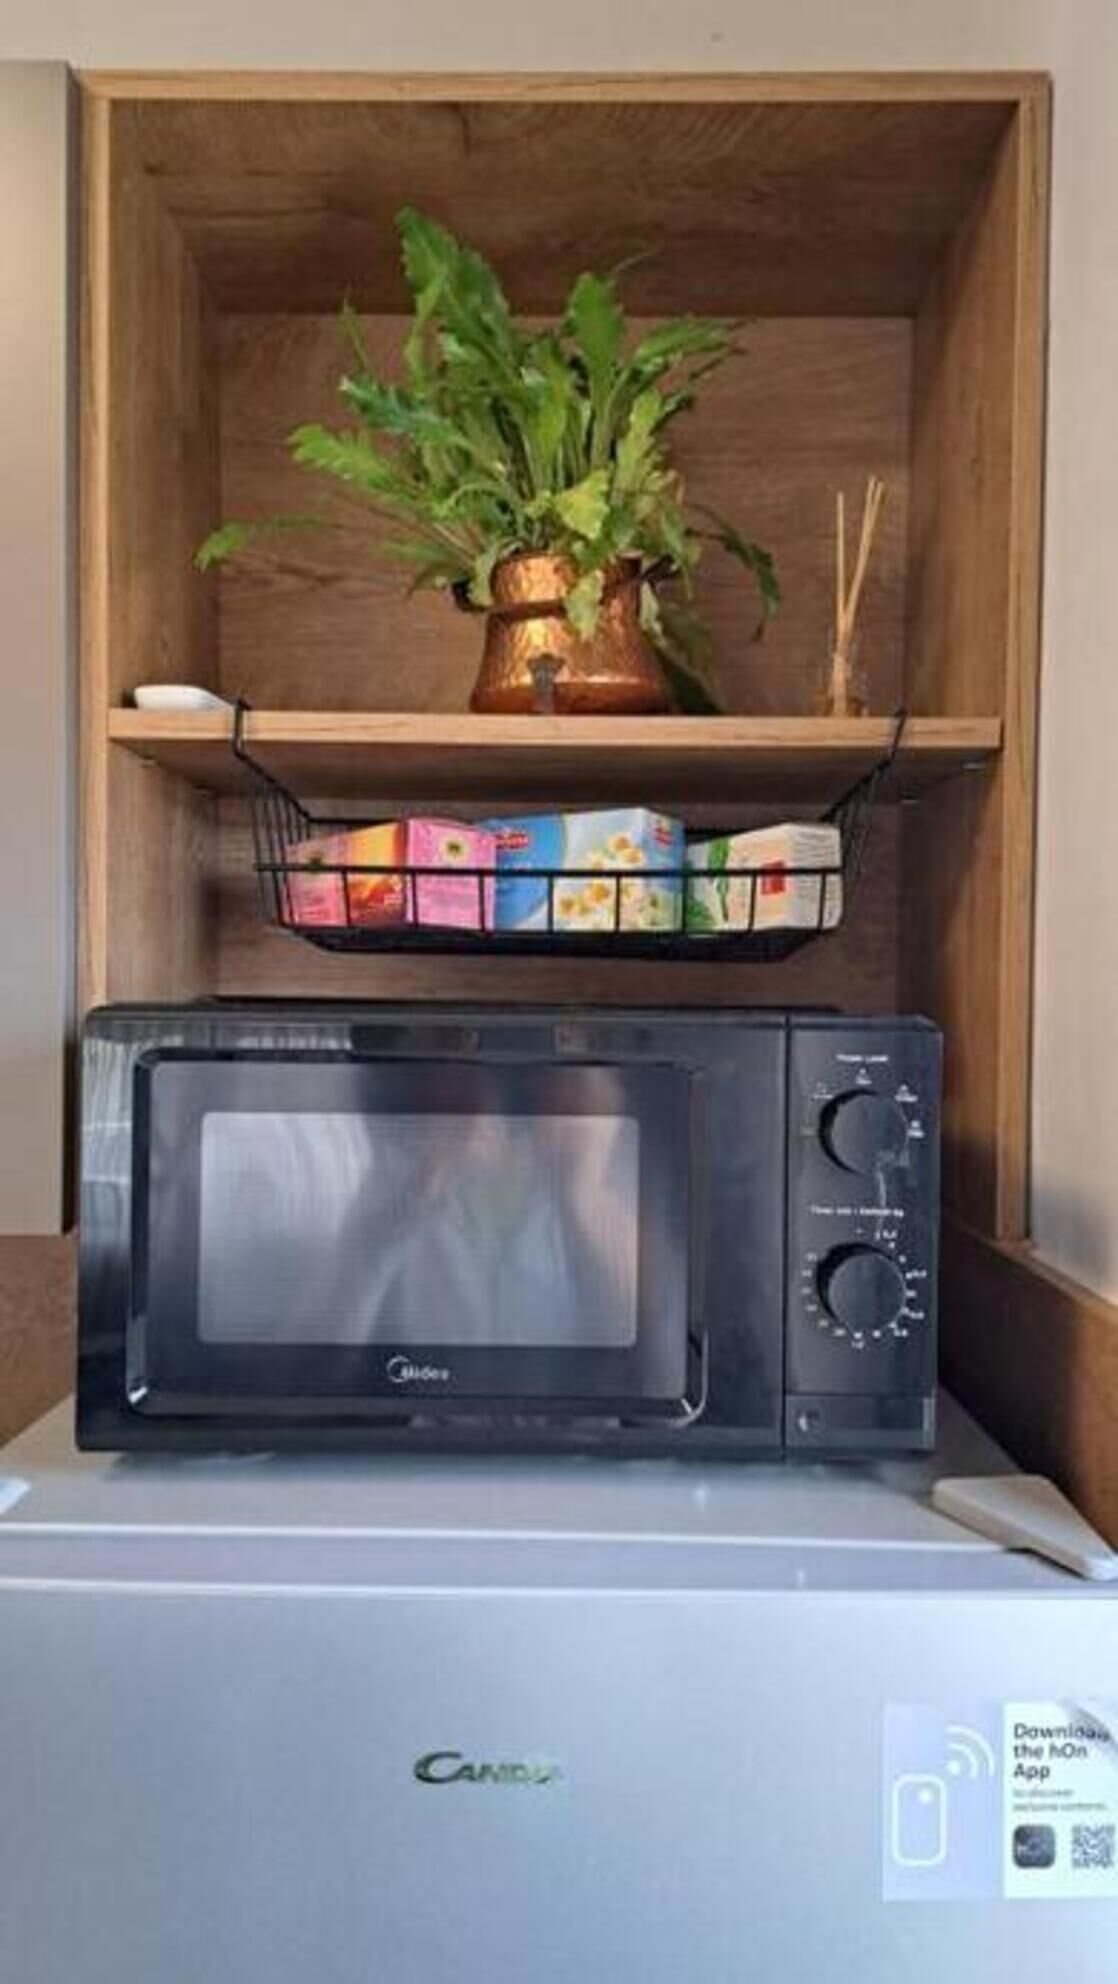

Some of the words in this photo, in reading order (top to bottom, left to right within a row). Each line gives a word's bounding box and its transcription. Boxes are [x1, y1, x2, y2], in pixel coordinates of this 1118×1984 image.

[1013, 1741, 1044, 1759] the
[1048, 1740, 1088, 1759] hOn
[1013, 1763, 1050, 1783] App
